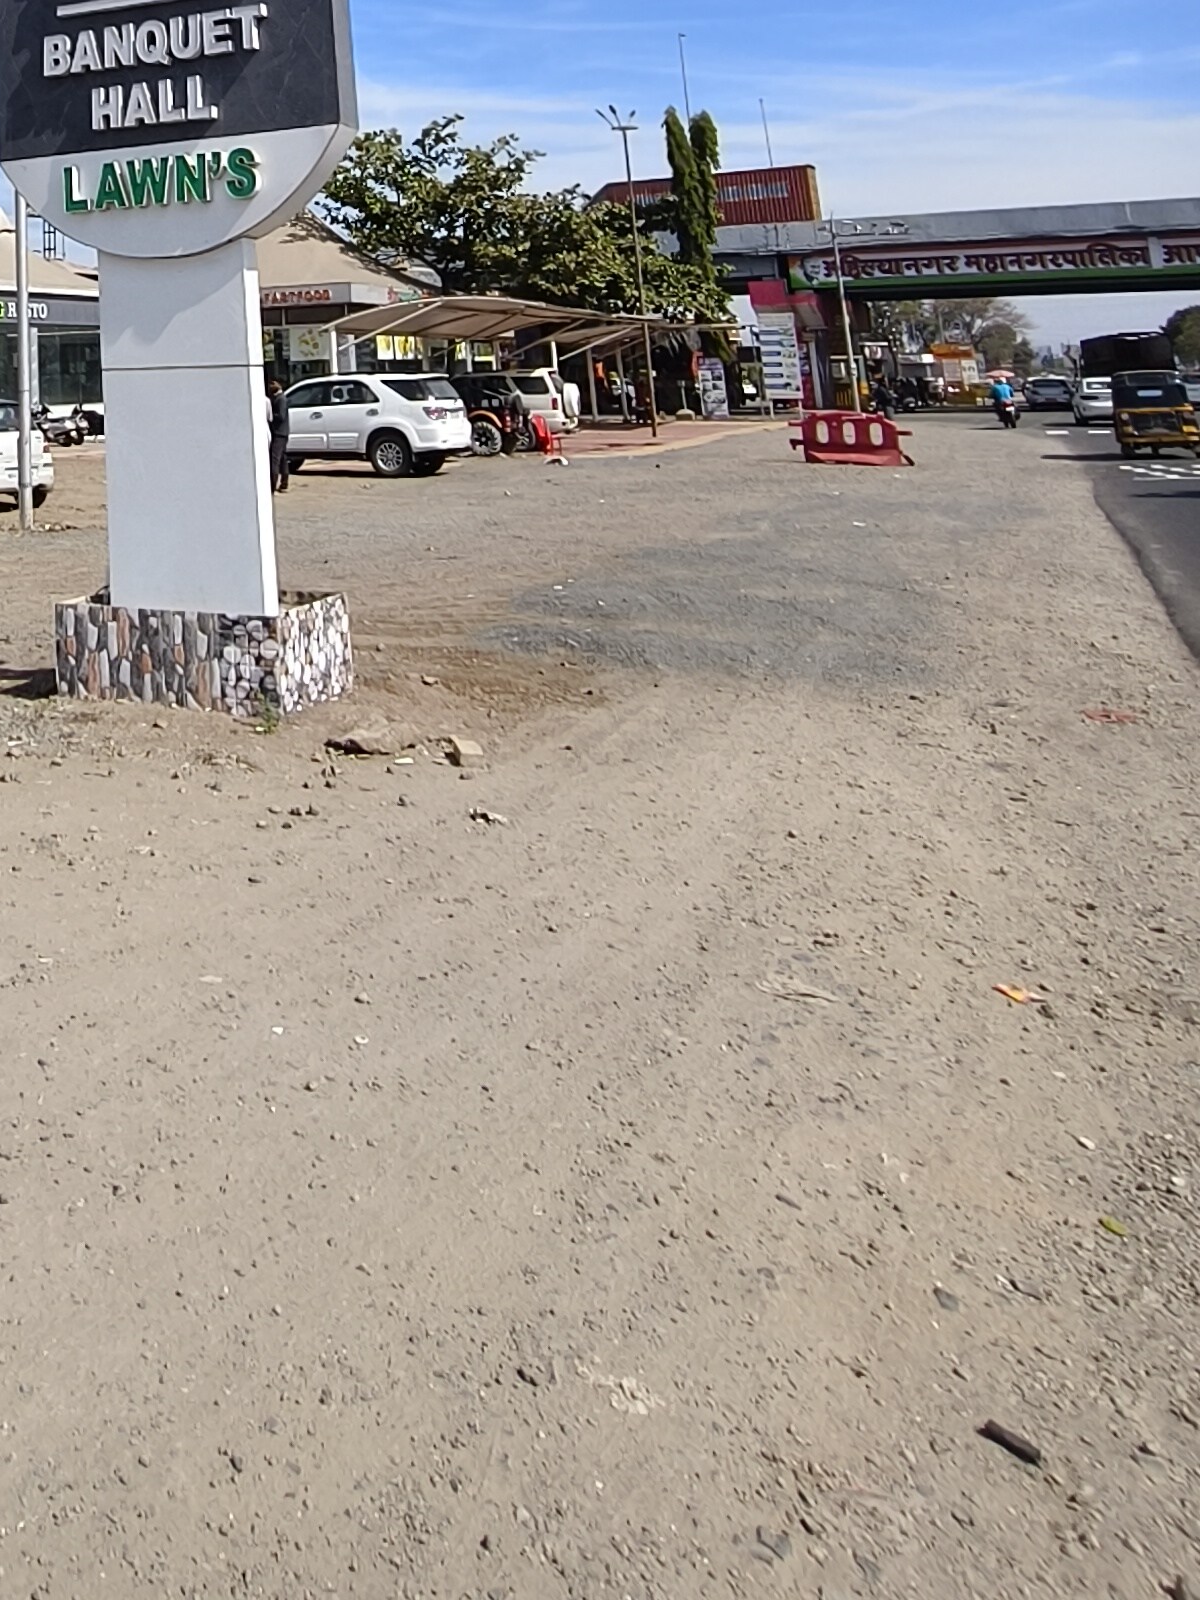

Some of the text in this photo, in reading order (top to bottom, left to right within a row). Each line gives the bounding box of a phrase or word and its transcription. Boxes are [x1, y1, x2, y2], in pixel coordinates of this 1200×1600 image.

[42, 3, 268, 78] BANQUET
[91, 74, 219, 131] HALL
[62, 147, 261, 214] LAWN'S
[963, 242, 1148, 274] महानगरपालिका
[1162, 244, 1200, 264] आ
